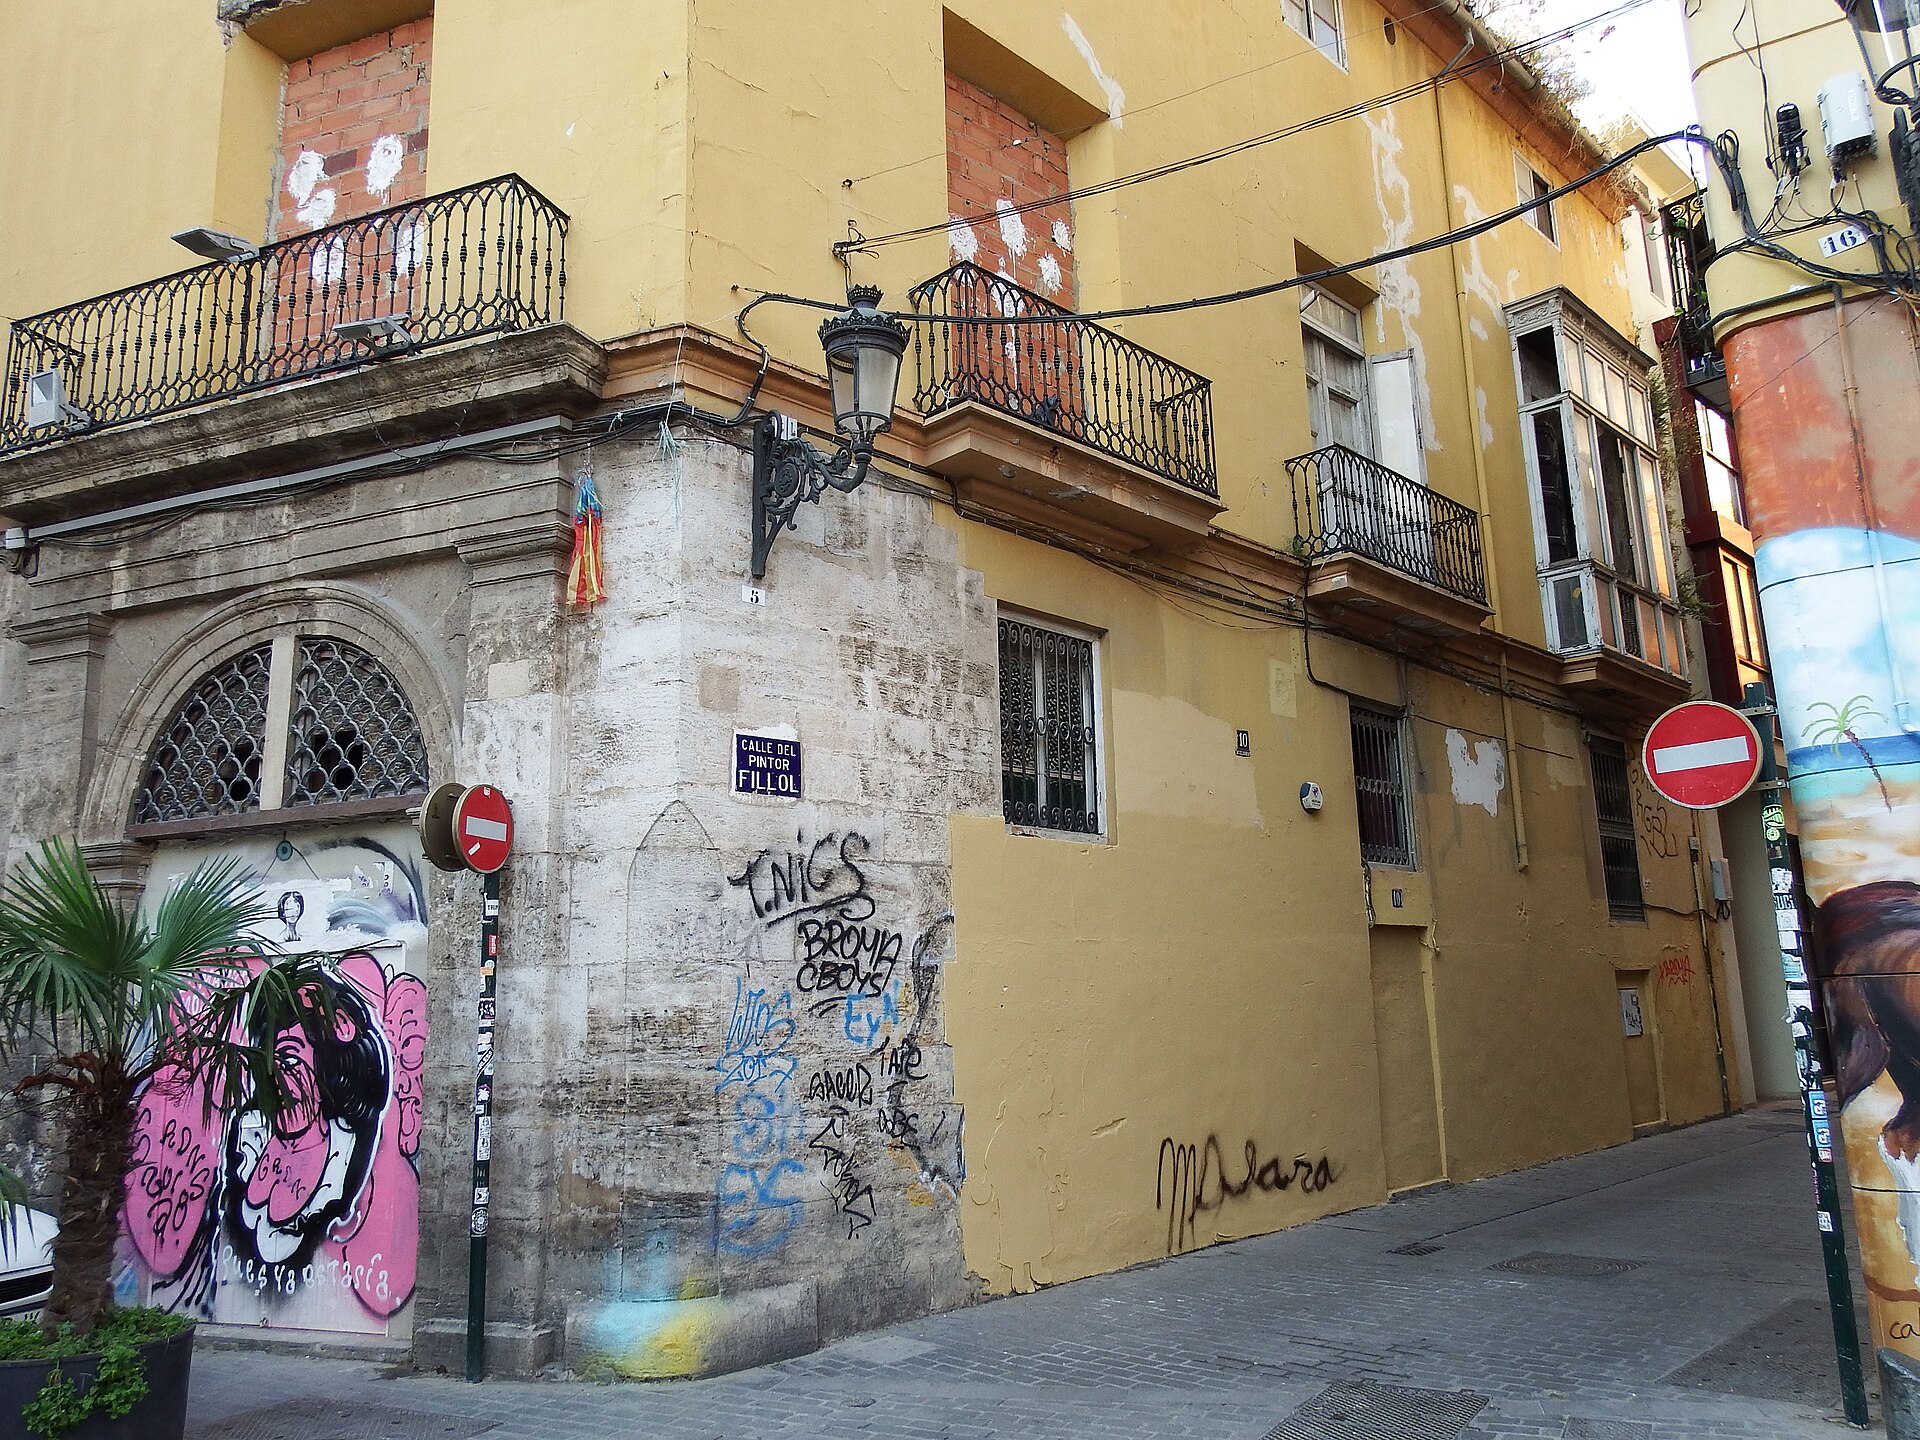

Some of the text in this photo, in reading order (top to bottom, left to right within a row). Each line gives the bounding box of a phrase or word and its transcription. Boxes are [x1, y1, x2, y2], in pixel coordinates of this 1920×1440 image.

[1826, 229, 1857, 254] 16
[741, 739, 797, 757] CALLE DEL
[1239, 732, 1248, 748] 10
[748, 754, 790, 771] PINTOR
[738, 769, 800, 793] FILLOL
